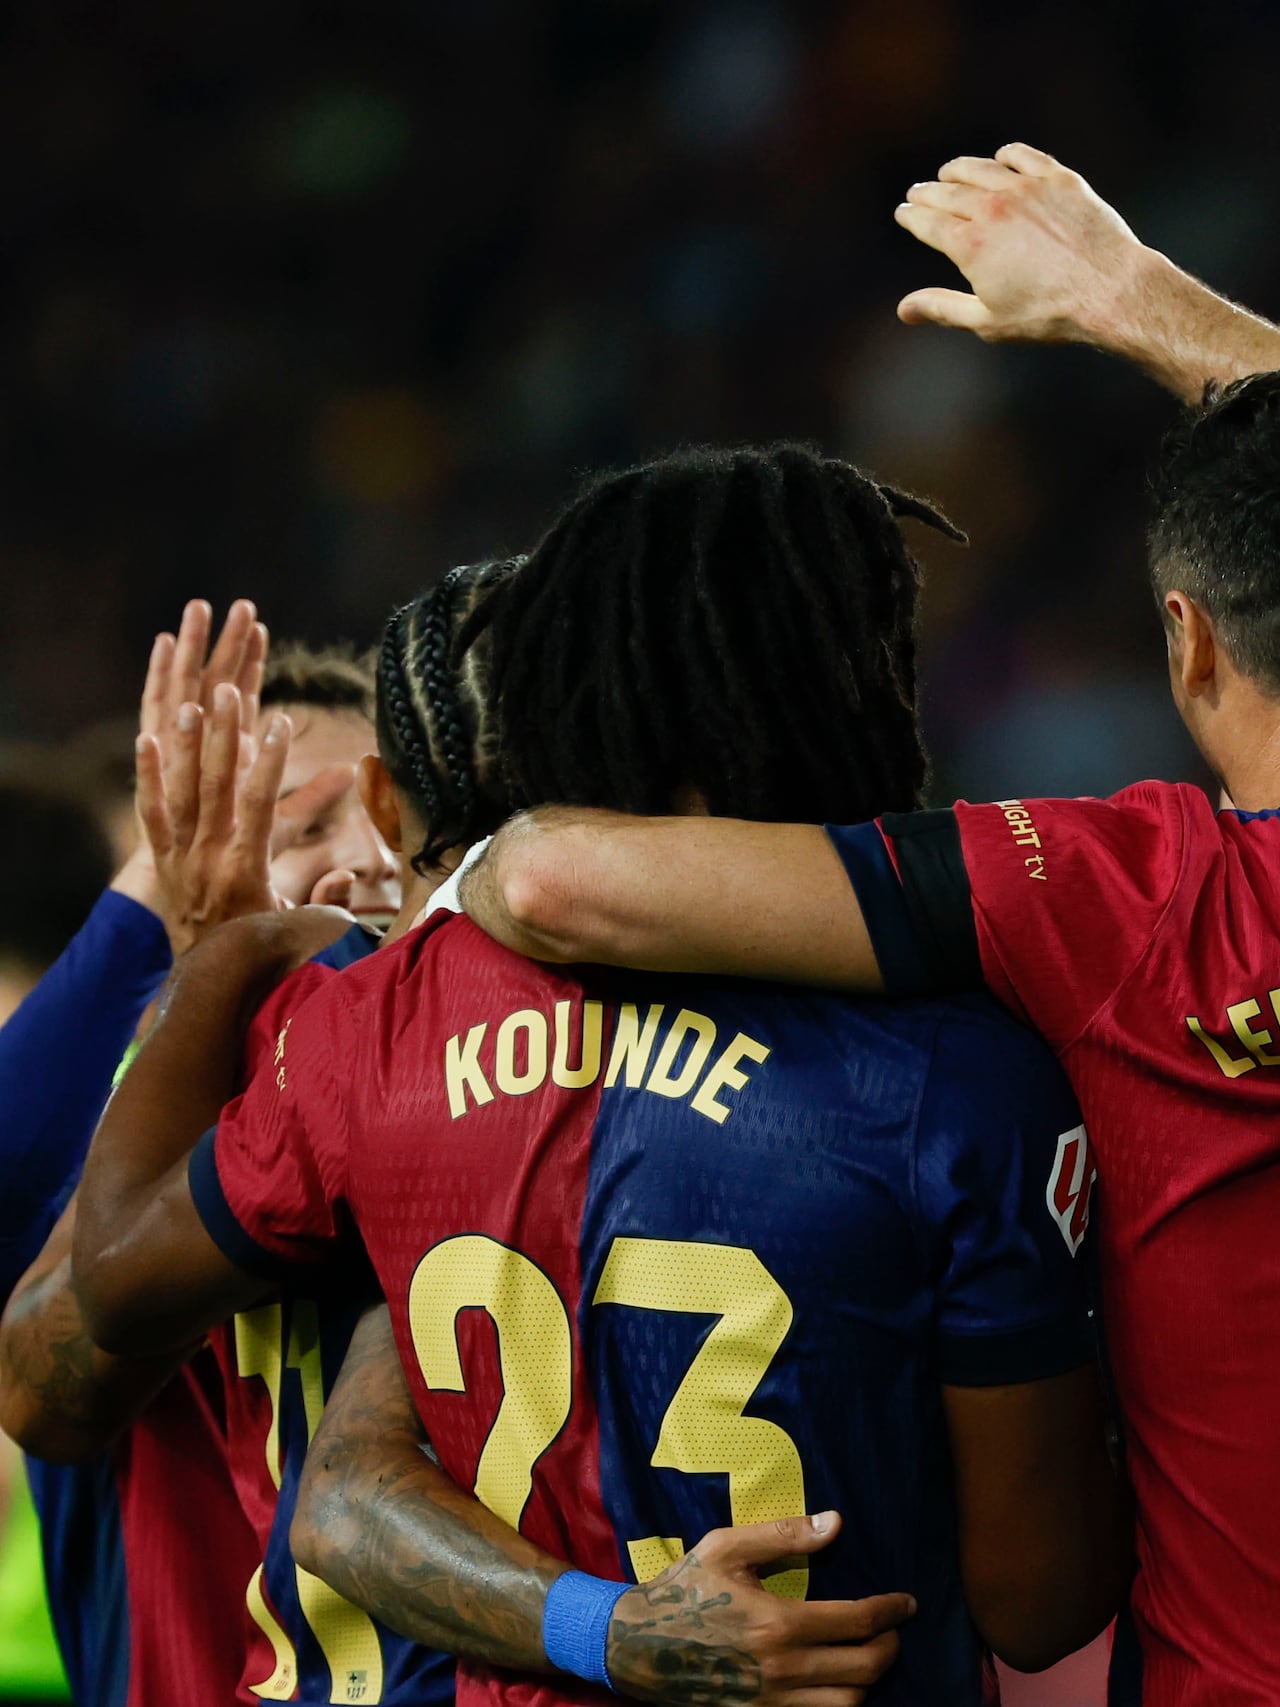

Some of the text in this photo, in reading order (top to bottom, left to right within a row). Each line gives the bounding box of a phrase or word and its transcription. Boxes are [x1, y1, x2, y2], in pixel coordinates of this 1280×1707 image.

[996, 799, 1048, 881] LIGHT tv
[445, 1000, 772, 1125] KOUNDE
[408, 1232, 811, 1603] 23
